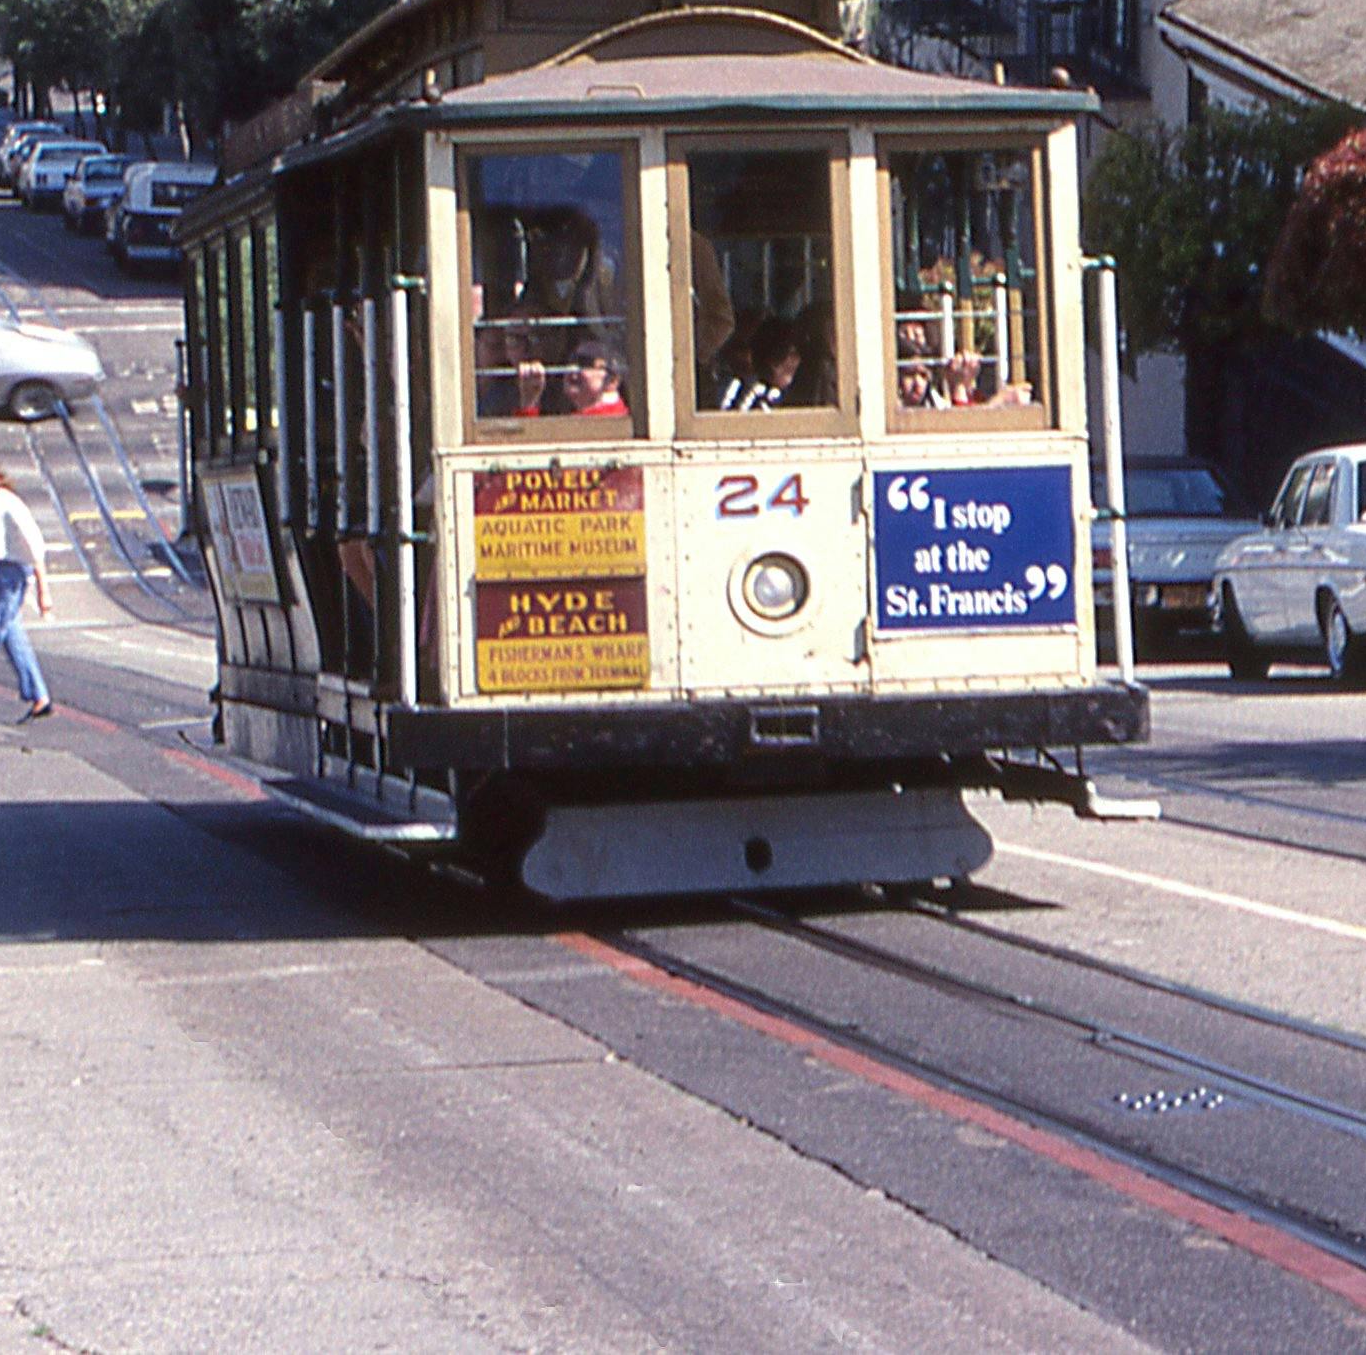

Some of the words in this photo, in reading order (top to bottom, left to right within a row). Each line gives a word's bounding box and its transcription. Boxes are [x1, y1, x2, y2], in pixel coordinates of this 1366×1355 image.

[520, 488, 618, 512] MARKET
[715, 472, 810, 519] 24
[481, 519, 565, 537] AQUATIC
[580, 516, 632, 533] PARK
[951, 499, 1011, 535] stop
[480, 541, 562, 559] MARITIME
[569, 538, 638, 555] MUSEUM
[913, 543, 943, 574] at
[946, 540, 991, 573] the
[509, 589, 615, 614] HYDE
[886, 584, 928, 617] St.
[528, 611, 629, 635] BEACH
[551, 666, 584, 682] FROM
